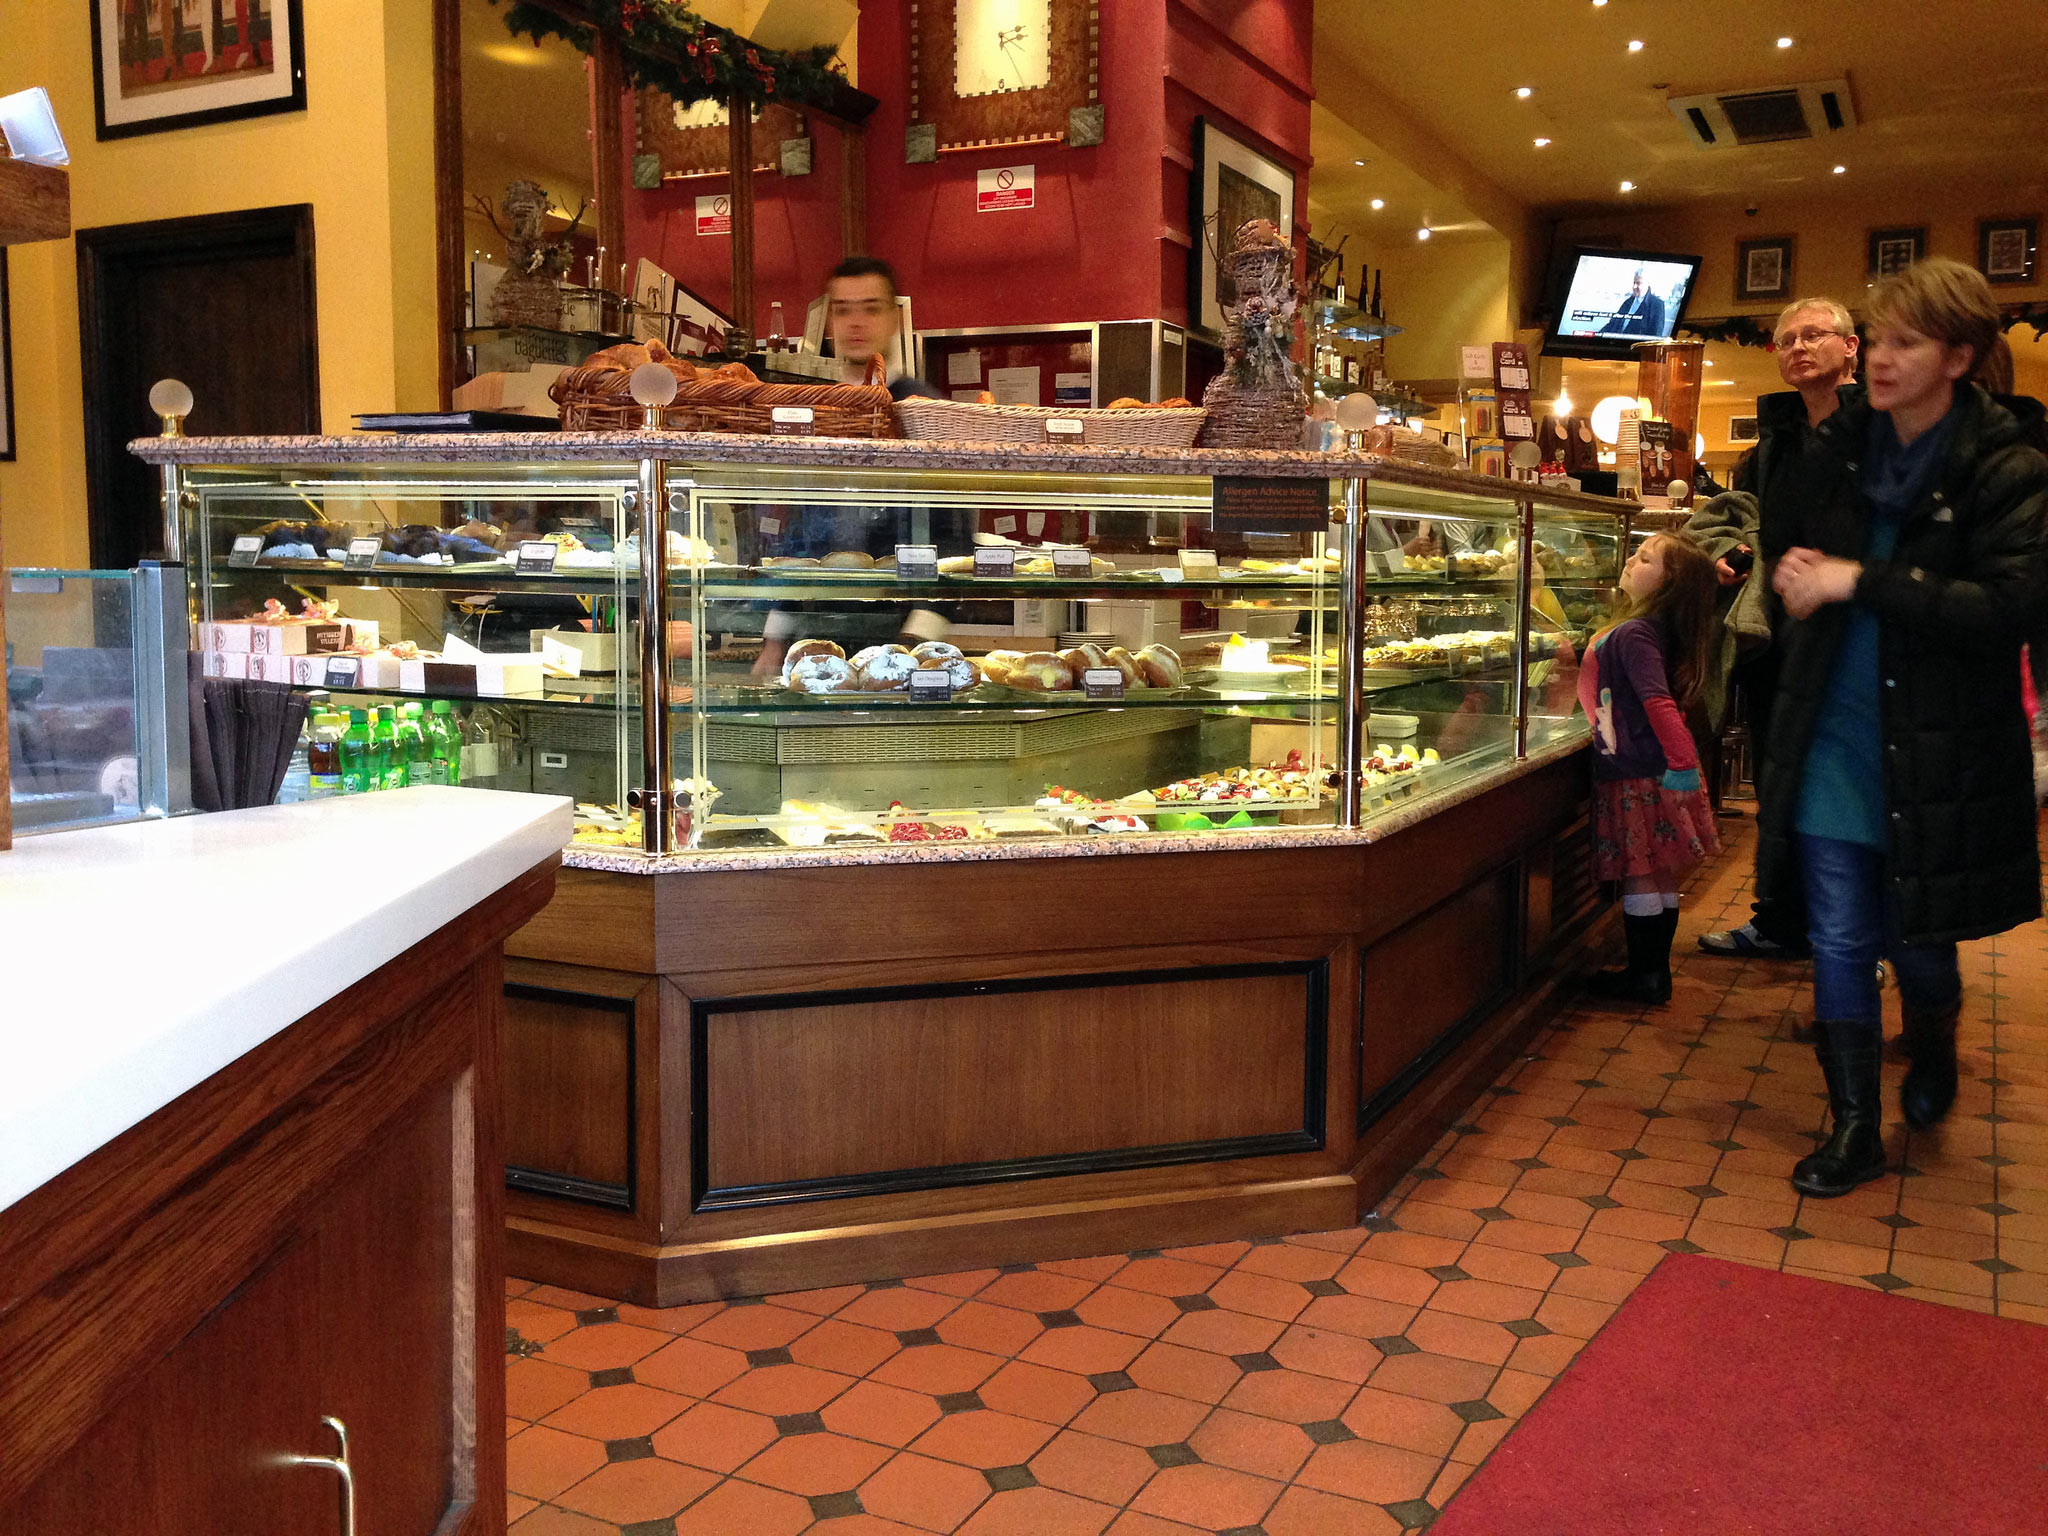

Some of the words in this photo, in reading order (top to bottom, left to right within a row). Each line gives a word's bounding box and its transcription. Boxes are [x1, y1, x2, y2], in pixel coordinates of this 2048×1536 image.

[998, 78, 1005, 90] 6
[1503, 406, 1519, 414] Card
[1223, 487, 1258, 497] Allergen
[1260, 487, 1288, 496] Advice
[1290, 487, 1318, 496] Notice
